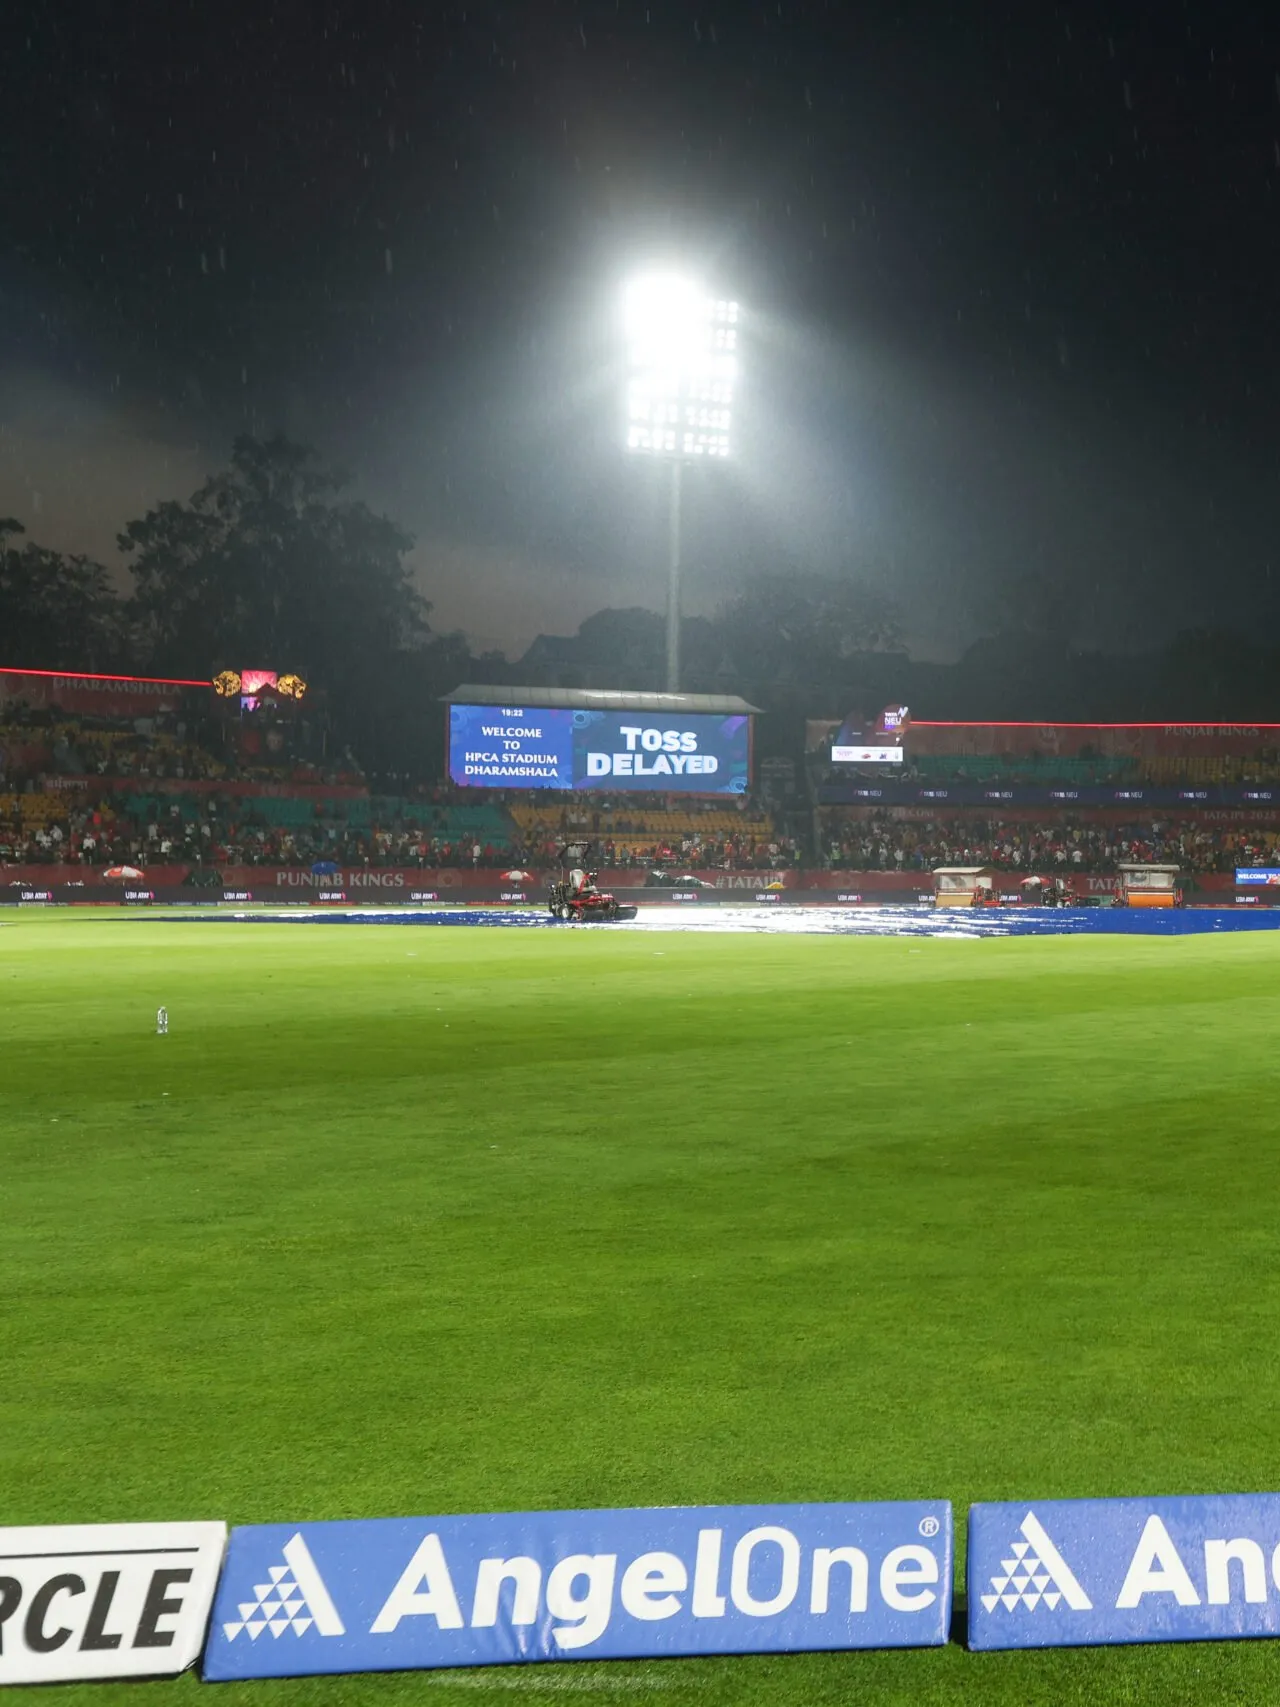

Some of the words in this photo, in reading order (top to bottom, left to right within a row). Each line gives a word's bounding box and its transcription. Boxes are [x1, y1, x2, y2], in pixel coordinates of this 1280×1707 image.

[481, 726, 542, 738] WELCOME
[503, 740, 520, 750] TO
[620, 726, 698, 752] TOSS
[465, 752, 499, 763] HPCA
[502, 753, 557, 764] STADIUM
[587, 752, 718, 776] DELAYED
[464, 765, 558, 777] DHARAMSHALA
[349, 872, 404, 888] KINGS
